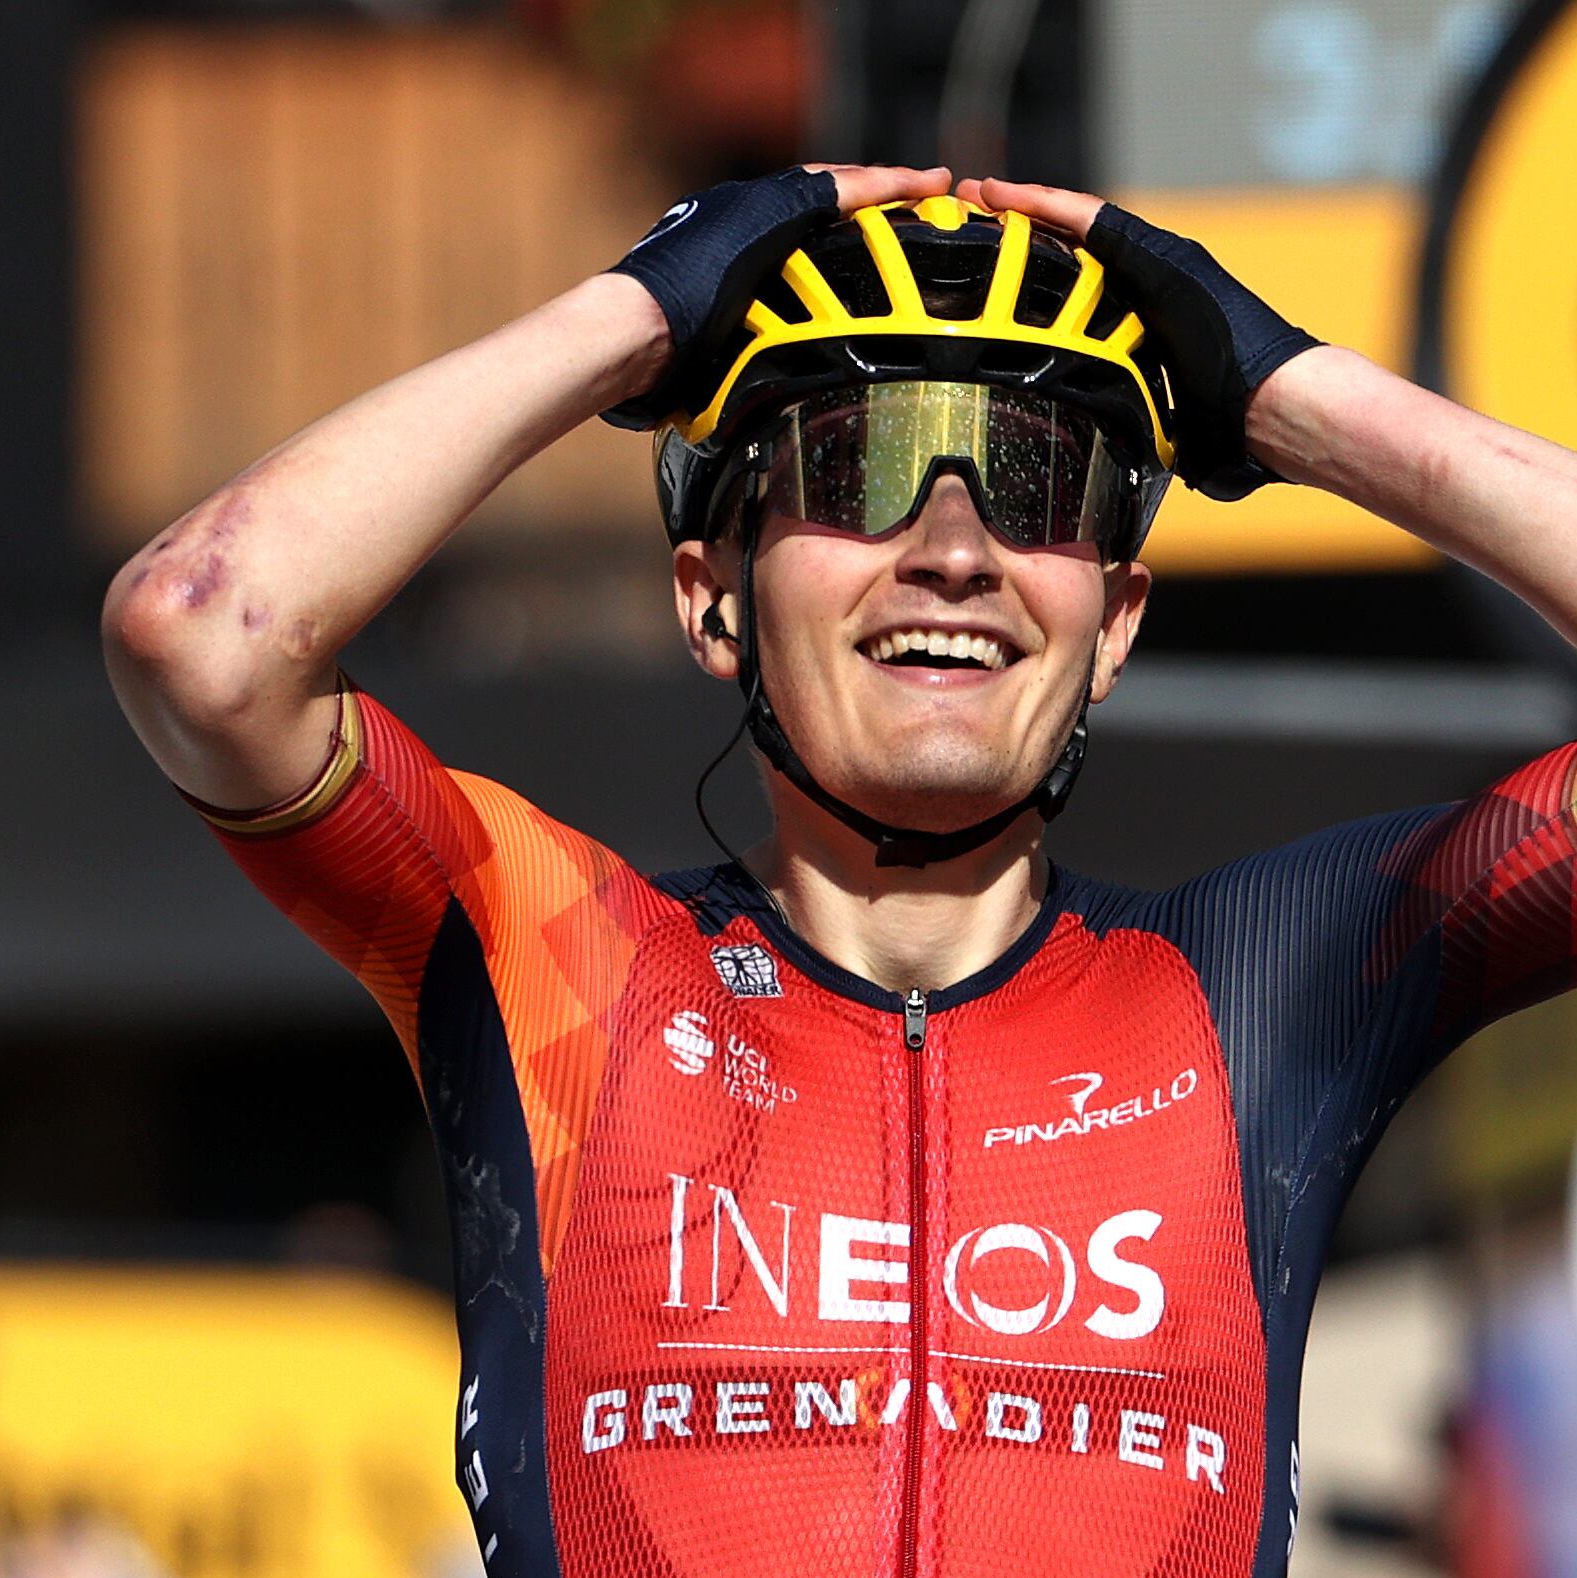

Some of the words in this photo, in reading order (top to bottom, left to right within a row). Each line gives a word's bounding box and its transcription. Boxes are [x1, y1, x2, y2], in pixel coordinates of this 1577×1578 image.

[724, 1053, 798, 1104] WORLD
[727, 1034, 767, 1073] UCI
[722, 1075, 776, 1116] TEAM
[983, 1067, 1198, 1149] PINARELLO
[660, 1173, 1164, 1341] INEOS
[581, 1378, 1226, 1495] GRENADIER
